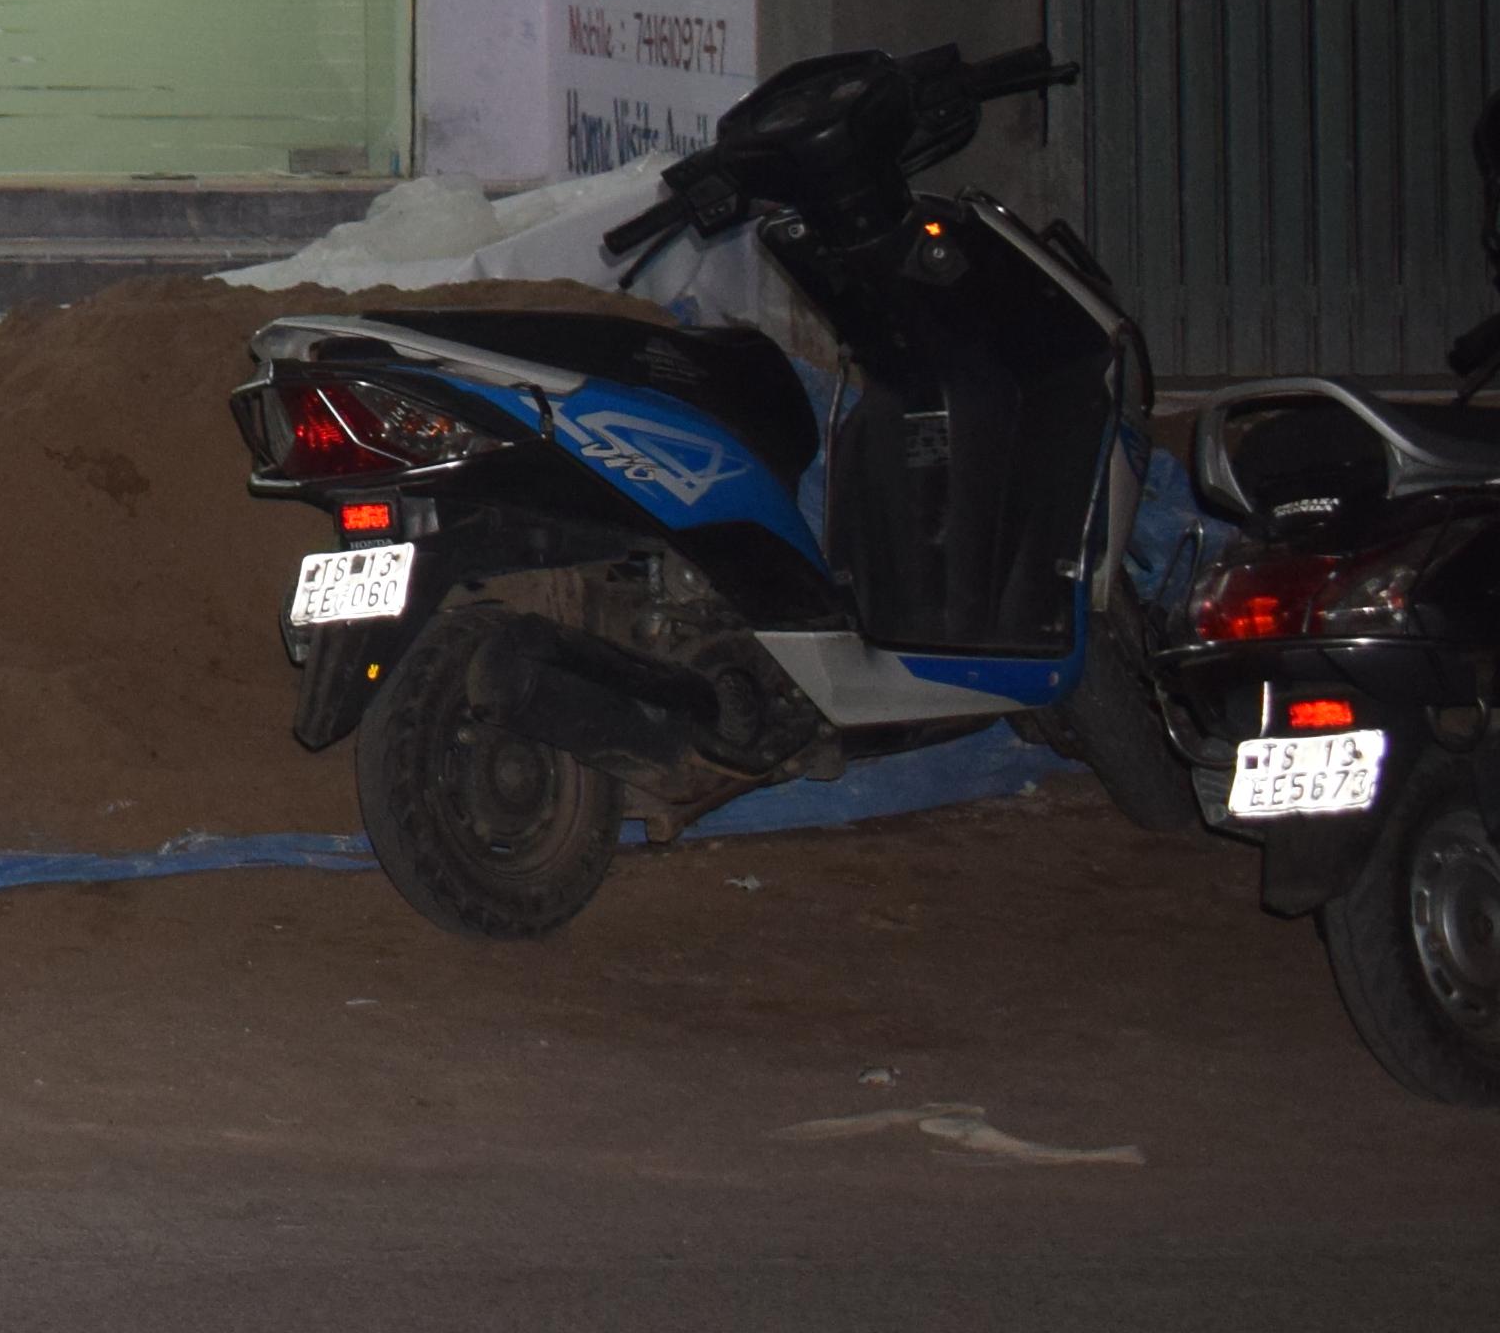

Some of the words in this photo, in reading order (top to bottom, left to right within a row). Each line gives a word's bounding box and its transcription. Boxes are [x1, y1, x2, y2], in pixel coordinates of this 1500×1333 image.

[634, 12, 726, 76] 7416109747
[321, 557, 348, 584] TS
[368, 552, 394, 578] 13
[305, 587, 336, 615] EE
[1263, 743, 1298, 770] TS
